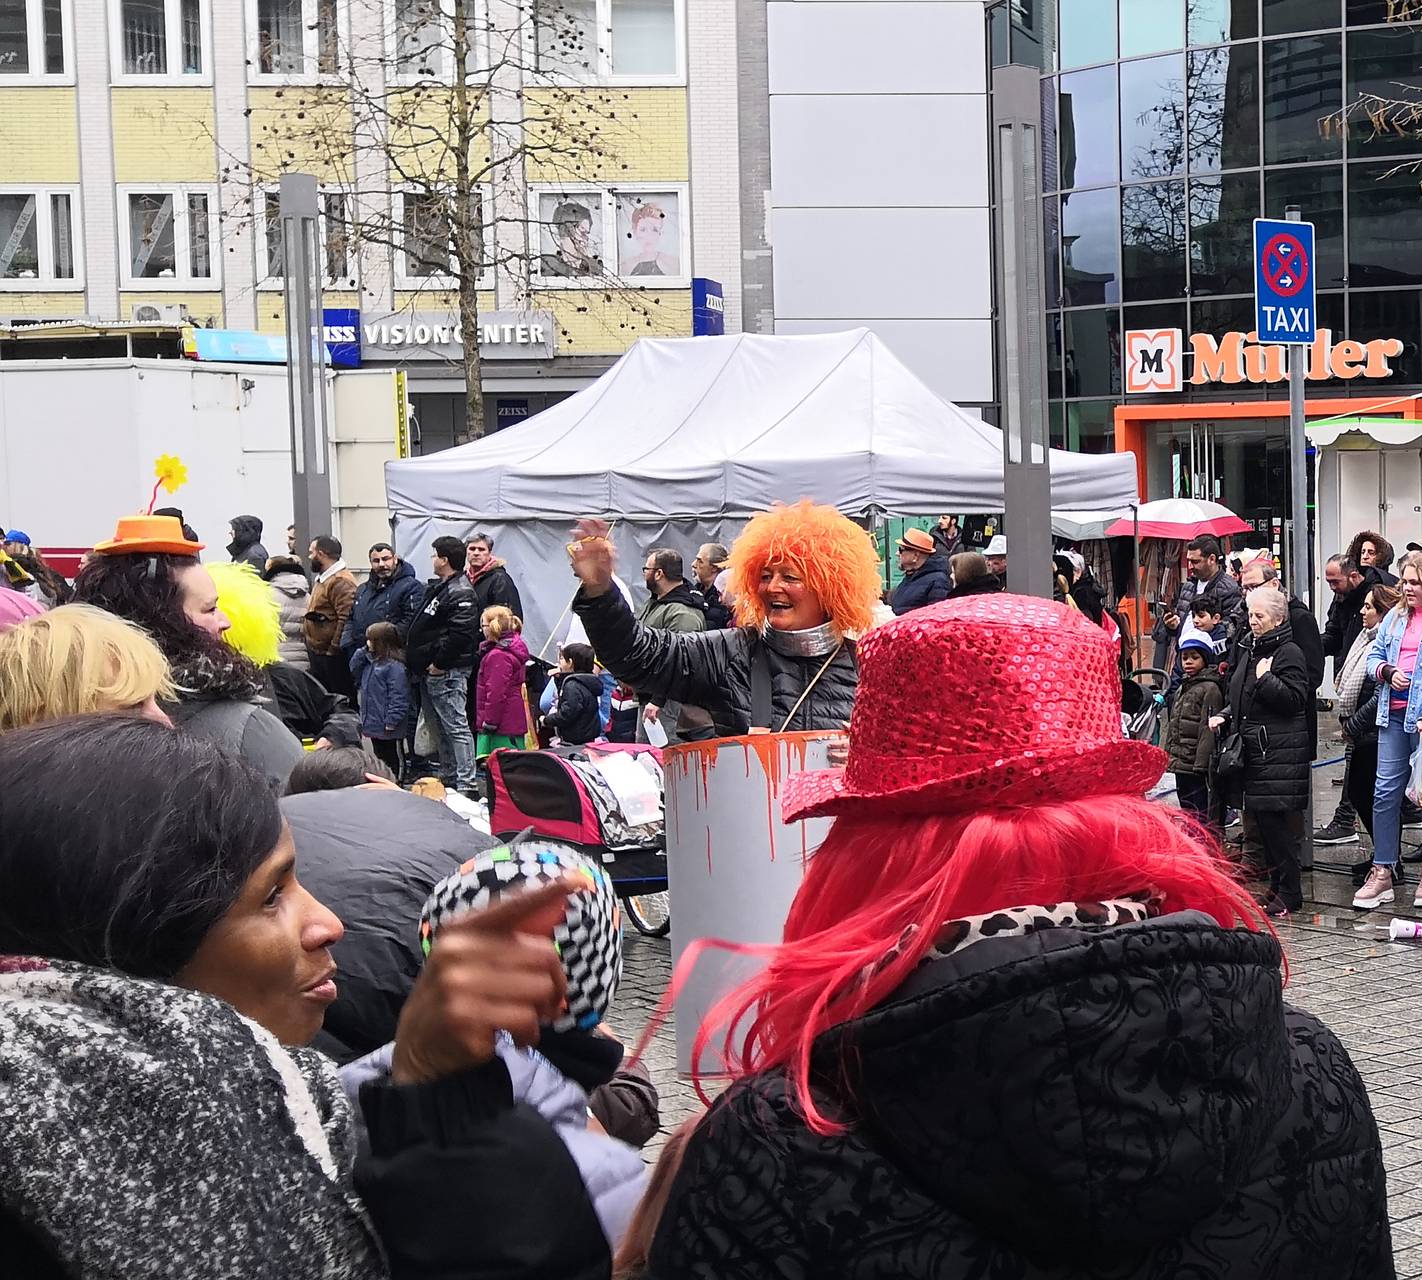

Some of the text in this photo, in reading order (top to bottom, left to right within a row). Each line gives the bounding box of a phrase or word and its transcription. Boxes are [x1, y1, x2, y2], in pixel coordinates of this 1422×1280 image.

[1262, 306, 1310, 333] TAXI
[310, 326, 357, 342] ISS
[364, 324, 450, 344] VISION
[1139, 349, 1164, 374] M
[1189, 328, 1405, 385] Müler
[498, 407, 528, 416] ZEISS
